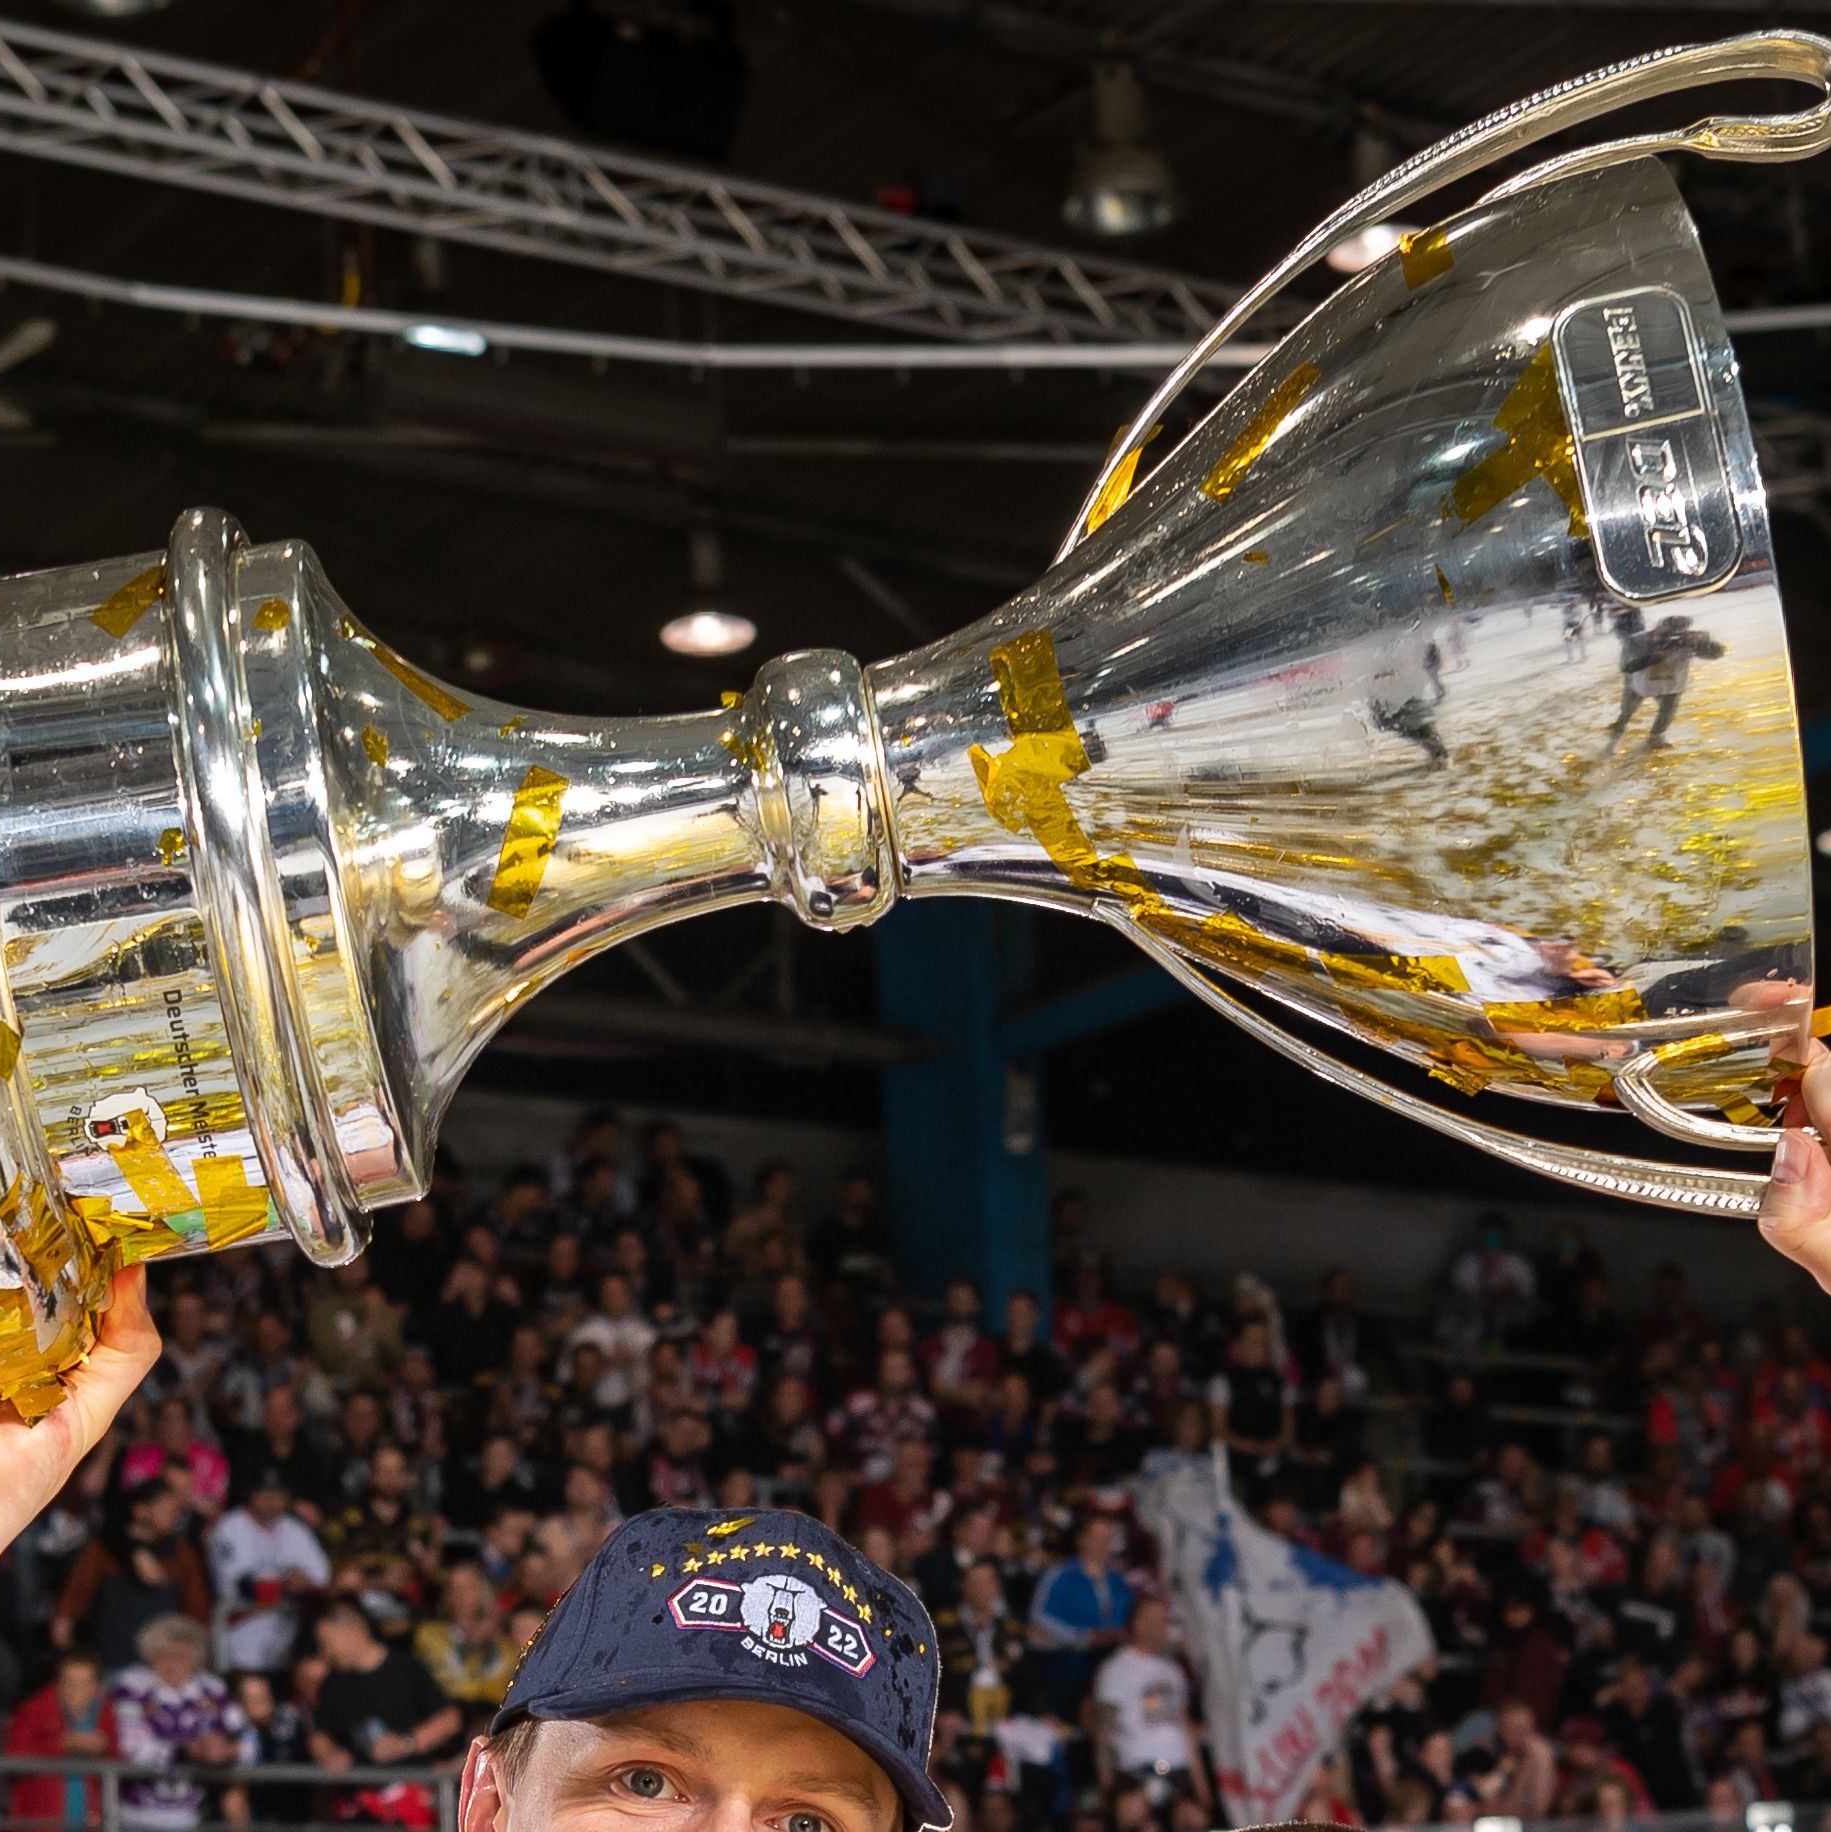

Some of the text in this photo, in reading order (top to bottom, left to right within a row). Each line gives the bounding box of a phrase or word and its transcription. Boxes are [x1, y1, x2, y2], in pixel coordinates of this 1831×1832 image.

[163, 989, 217, 1159] Deutscher Meiste
[688, 1590, 729, 1616] 20
[739, 1635, 811, 1667] BERLIN
[825, 1623, 860, 1660] 22
